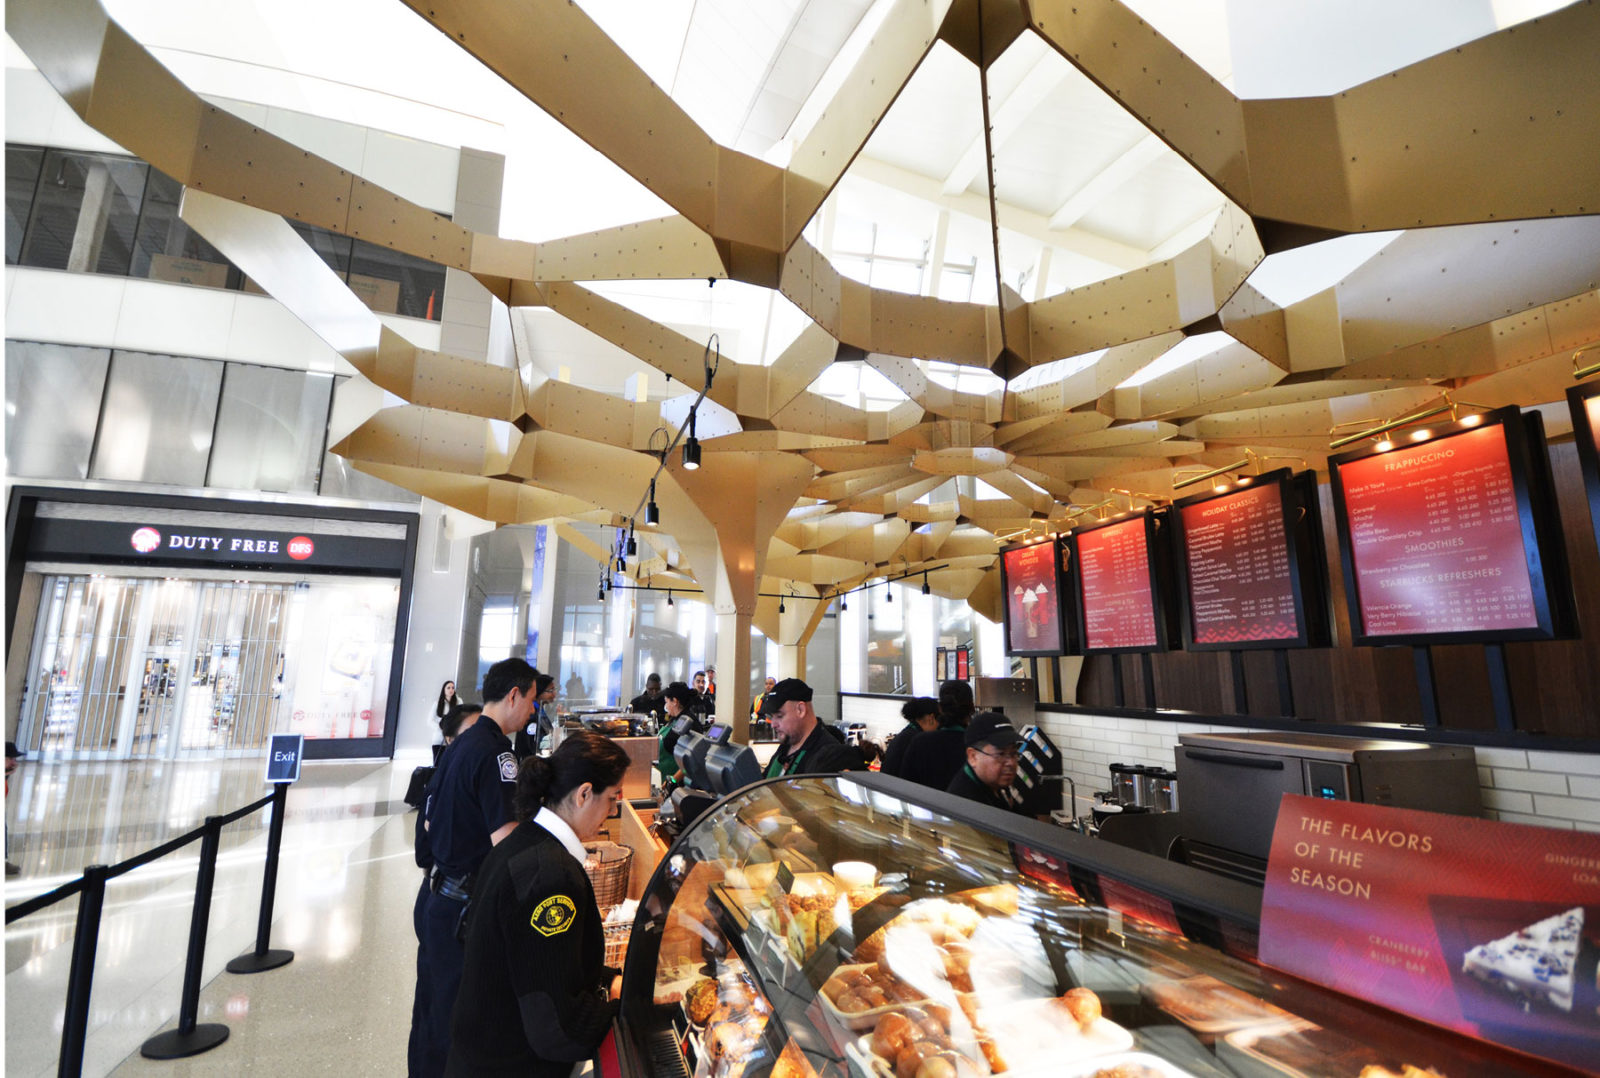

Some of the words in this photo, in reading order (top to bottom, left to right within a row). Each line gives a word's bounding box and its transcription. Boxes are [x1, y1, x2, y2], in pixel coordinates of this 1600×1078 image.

[1384, 450, 1454, 472] FRAPPUCCINO
[1202, 506, 1228, 517] HOLIDAY
[1229, 498, 1259, 510] CLASSICS
[169, 535, 223, 550] DUTY
[230, 539, 279, 552] FREE
[290, 544, 312, 554] DFS
[1405, 538, 1464, 554] SMOOTHIES
[1380, 576, 1434, 588] STARBUCKS
[1438, 568, 1501, 582] REFRESHERS
[274, 752, 296, 762] Exit
[1300, 817, 1333, 835] THE
[1340, 824, 1432, 852] FLAVORS
[1294, 842, 1320, 858] OF
[1328, 848, 1364, 869] THE
[1290, 868, 1372, 900] SEASON
[1368, 935, 1430, 958] CRANBERRY
[1406, 960, 1426, 974] BAR
